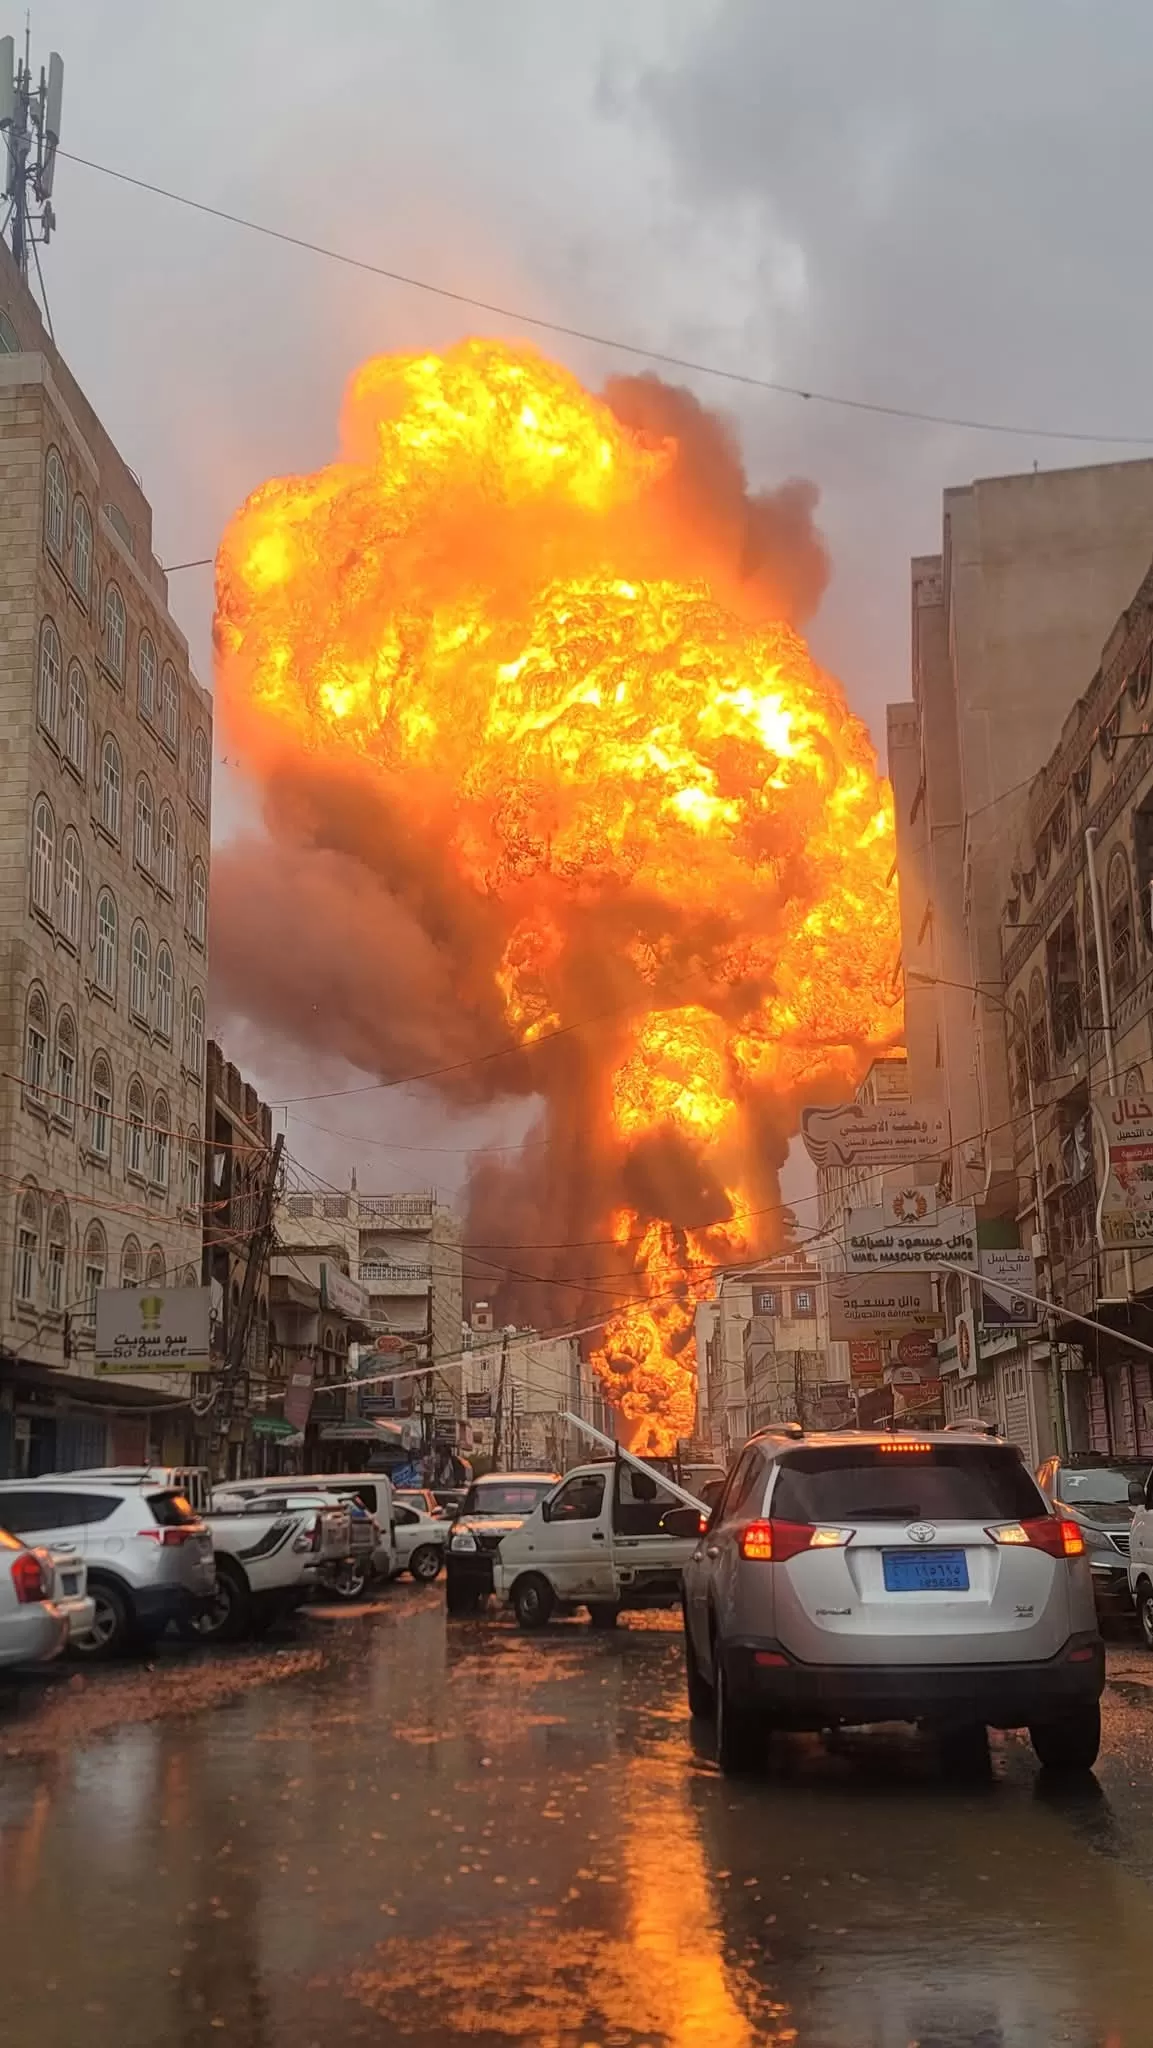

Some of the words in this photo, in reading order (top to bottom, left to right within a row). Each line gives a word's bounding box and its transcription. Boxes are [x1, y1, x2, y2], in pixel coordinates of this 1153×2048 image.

[1116, 1127, 1145, 1141] التجميل
[851, 1235, 894, 1249] للصرافة
[898, 1237, 943, 1249] مسعود
[945, 1233, 973, 1249] وائل
[851, 1252, 878, 1262] WAEL
[880, 1252, 921, 1262] MASOUD
[924, 1251, 973, 1261] EXCHANGE
[988, 1251, 1031, 1265] مغاسل
[843, 1297, 896, 1310] مسعود
[114, 1334, 161, 1349] سويت
[164, 1335, 187, 1348] سو
[113, 1346, 133, 1358] So
[137, 1346, 188, 1358] Sweet
